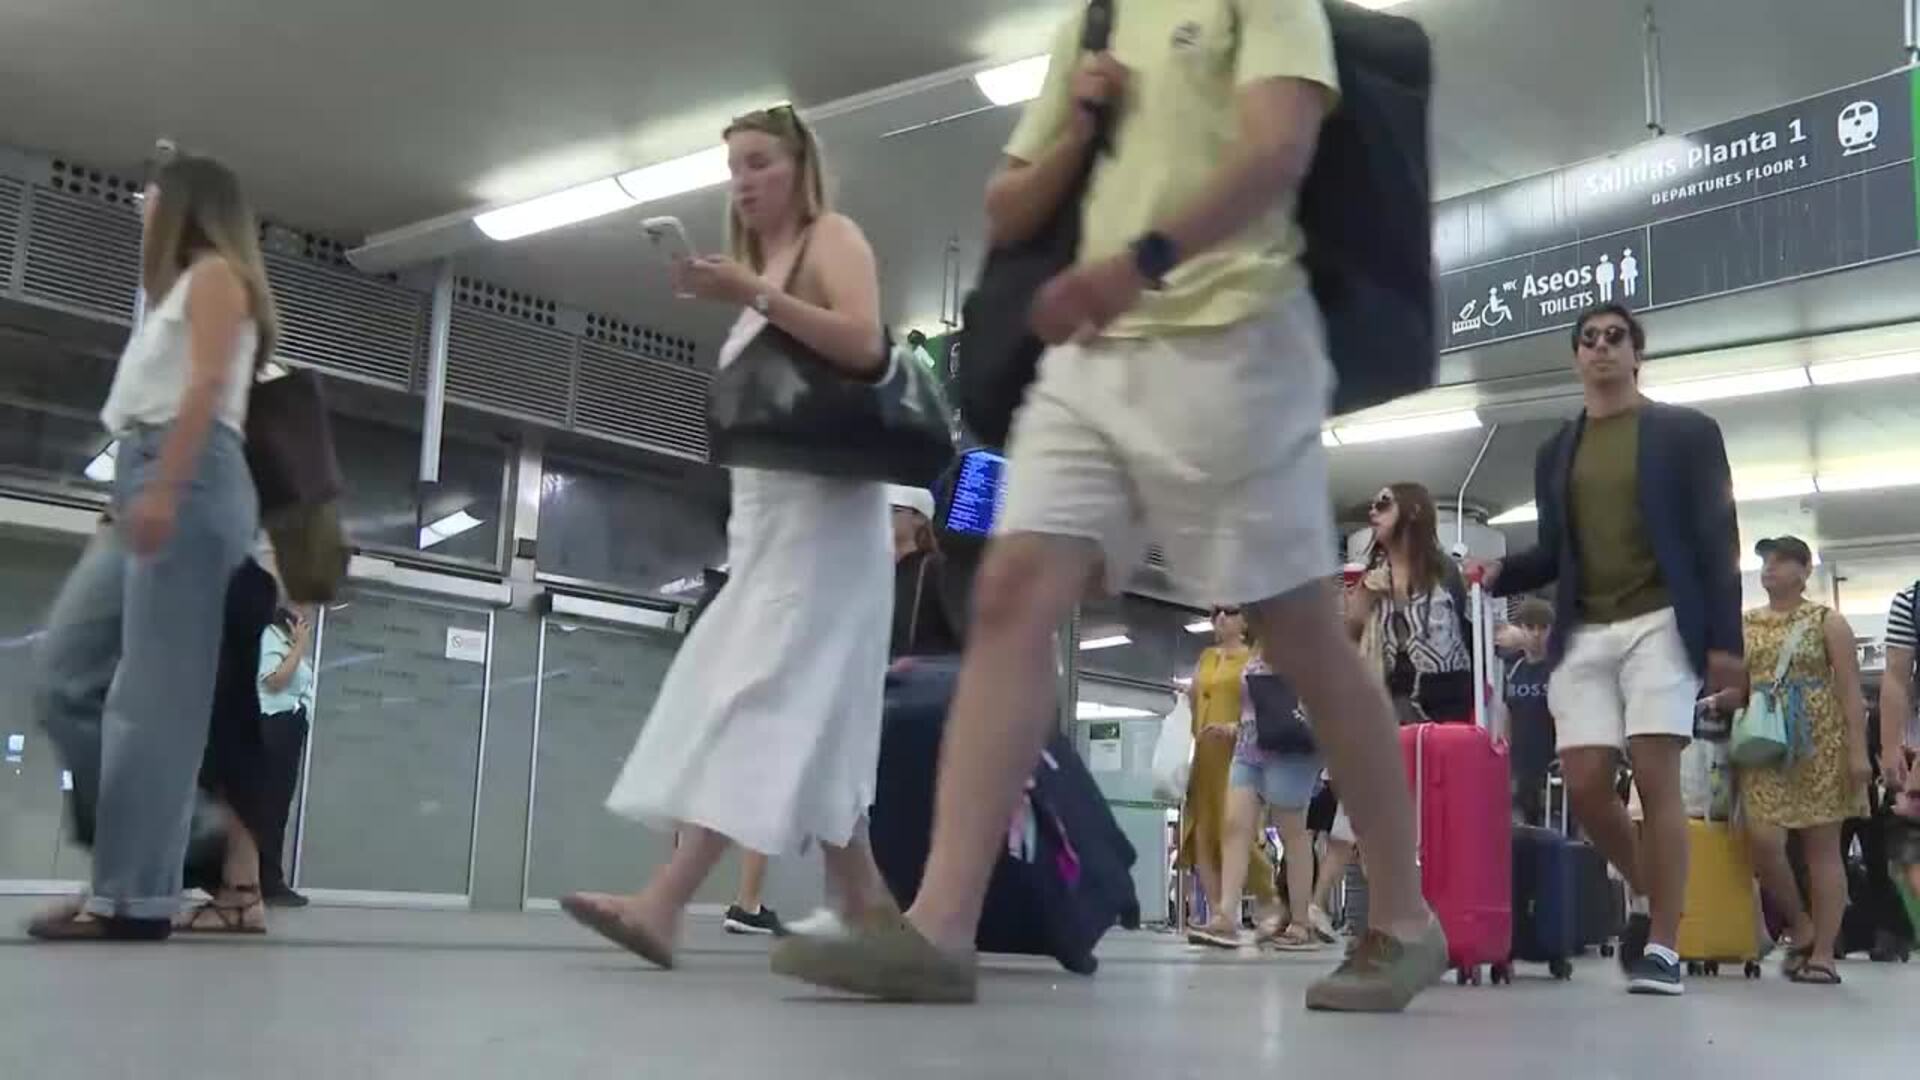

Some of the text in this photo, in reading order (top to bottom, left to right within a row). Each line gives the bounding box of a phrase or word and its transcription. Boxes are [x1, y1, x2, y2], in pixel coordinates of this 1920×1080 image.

[1584, 119, 1807, 195] Salidas Planta 1
[1651, 155, 1809, 206] DEPARTURES FLOOR 1
[1522, 265, 1592, 299] Aseos
[1539, 290, 1594, 316] TOILETS
